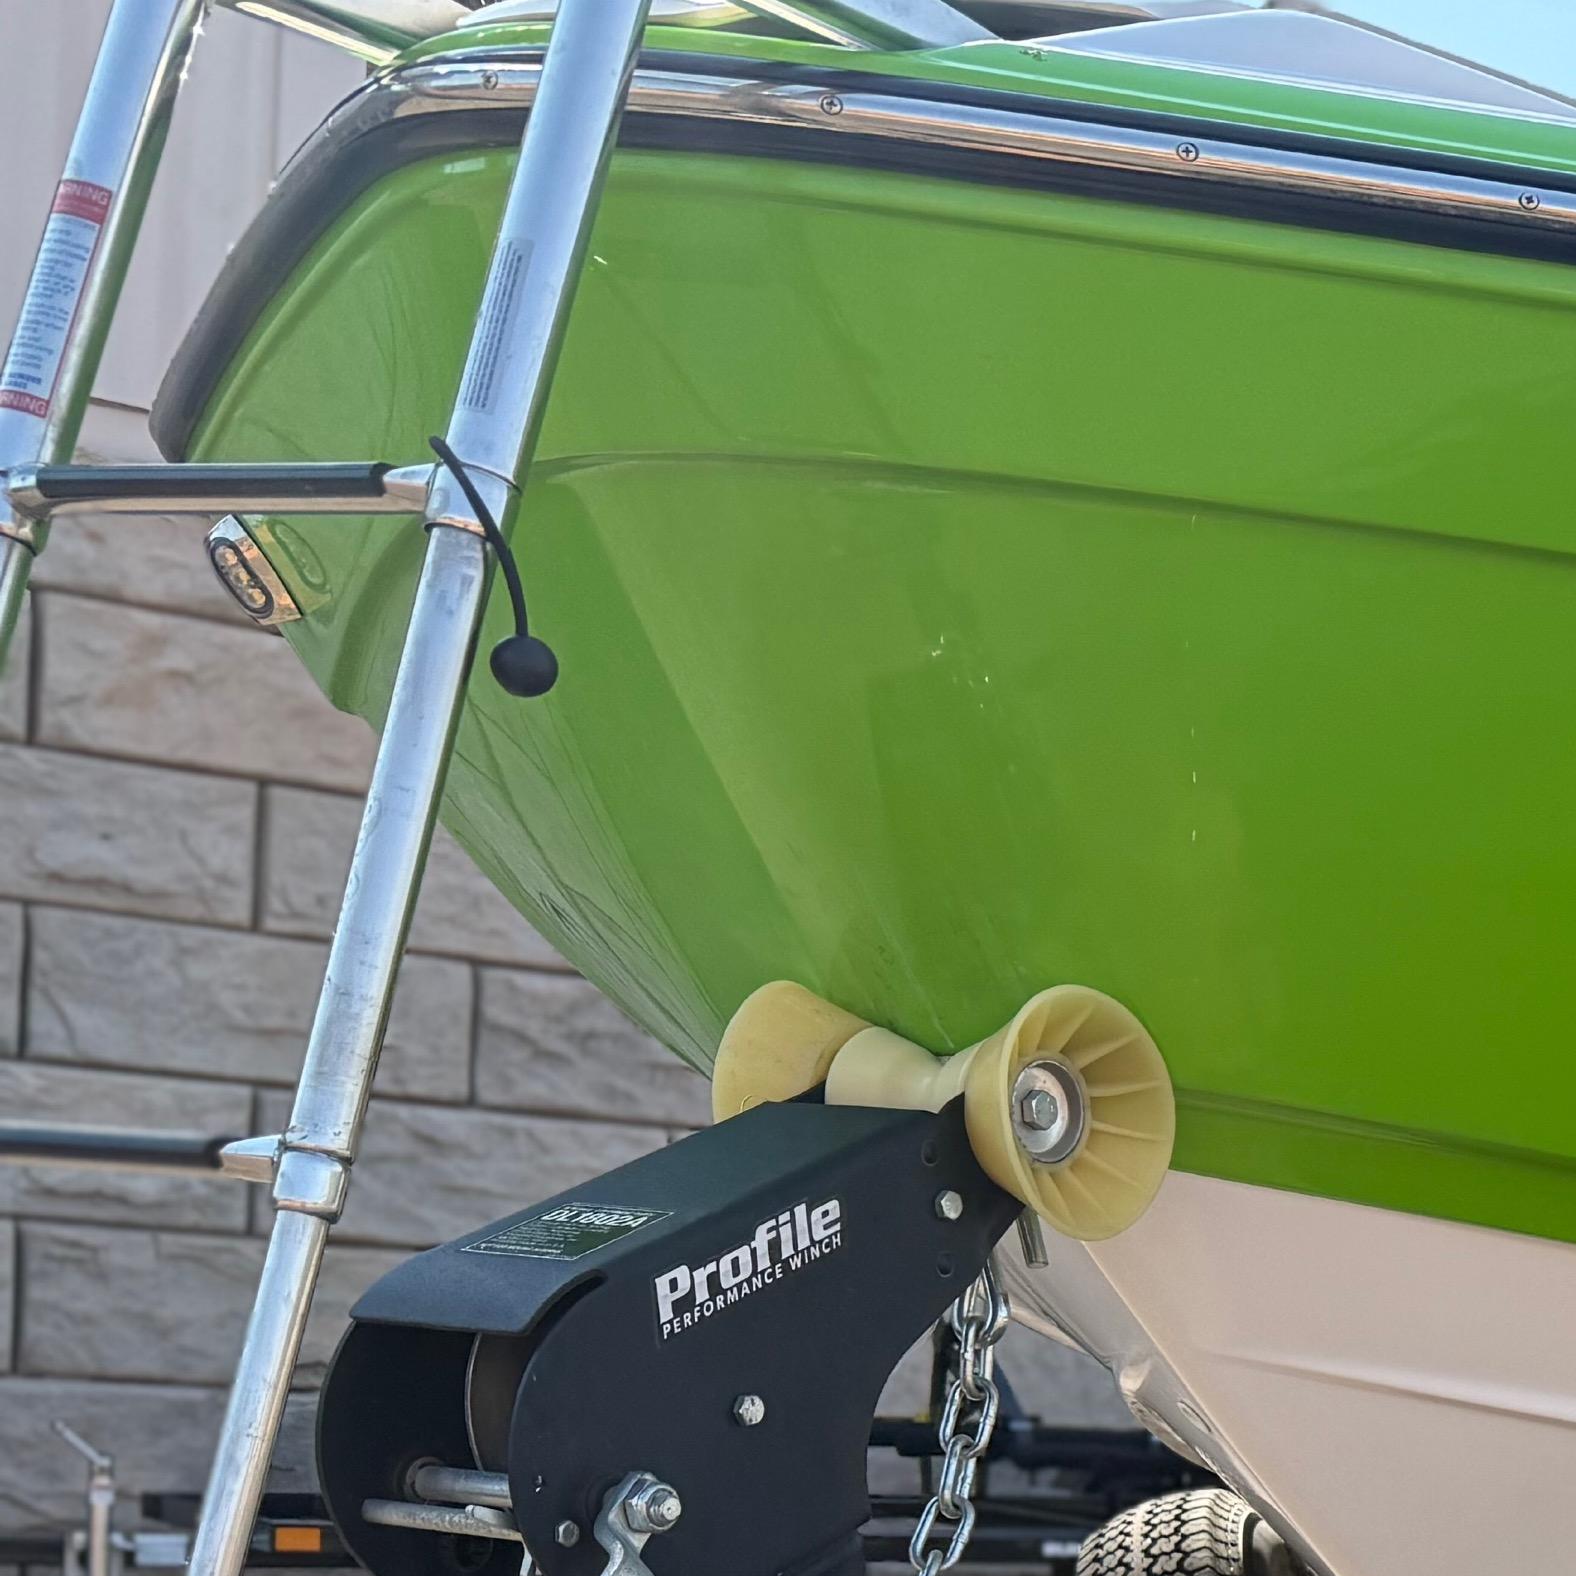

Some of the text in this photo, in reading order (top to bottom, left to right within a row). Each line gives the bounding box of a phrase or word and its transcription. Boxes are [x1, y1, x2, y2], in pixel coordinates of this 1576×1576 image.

[541, 1209, 648, 1227] DL1802A
[655, 1200, 841, 1324] Profile
[662, 1233, 842, 1340] PERFORMANCE WINCH
